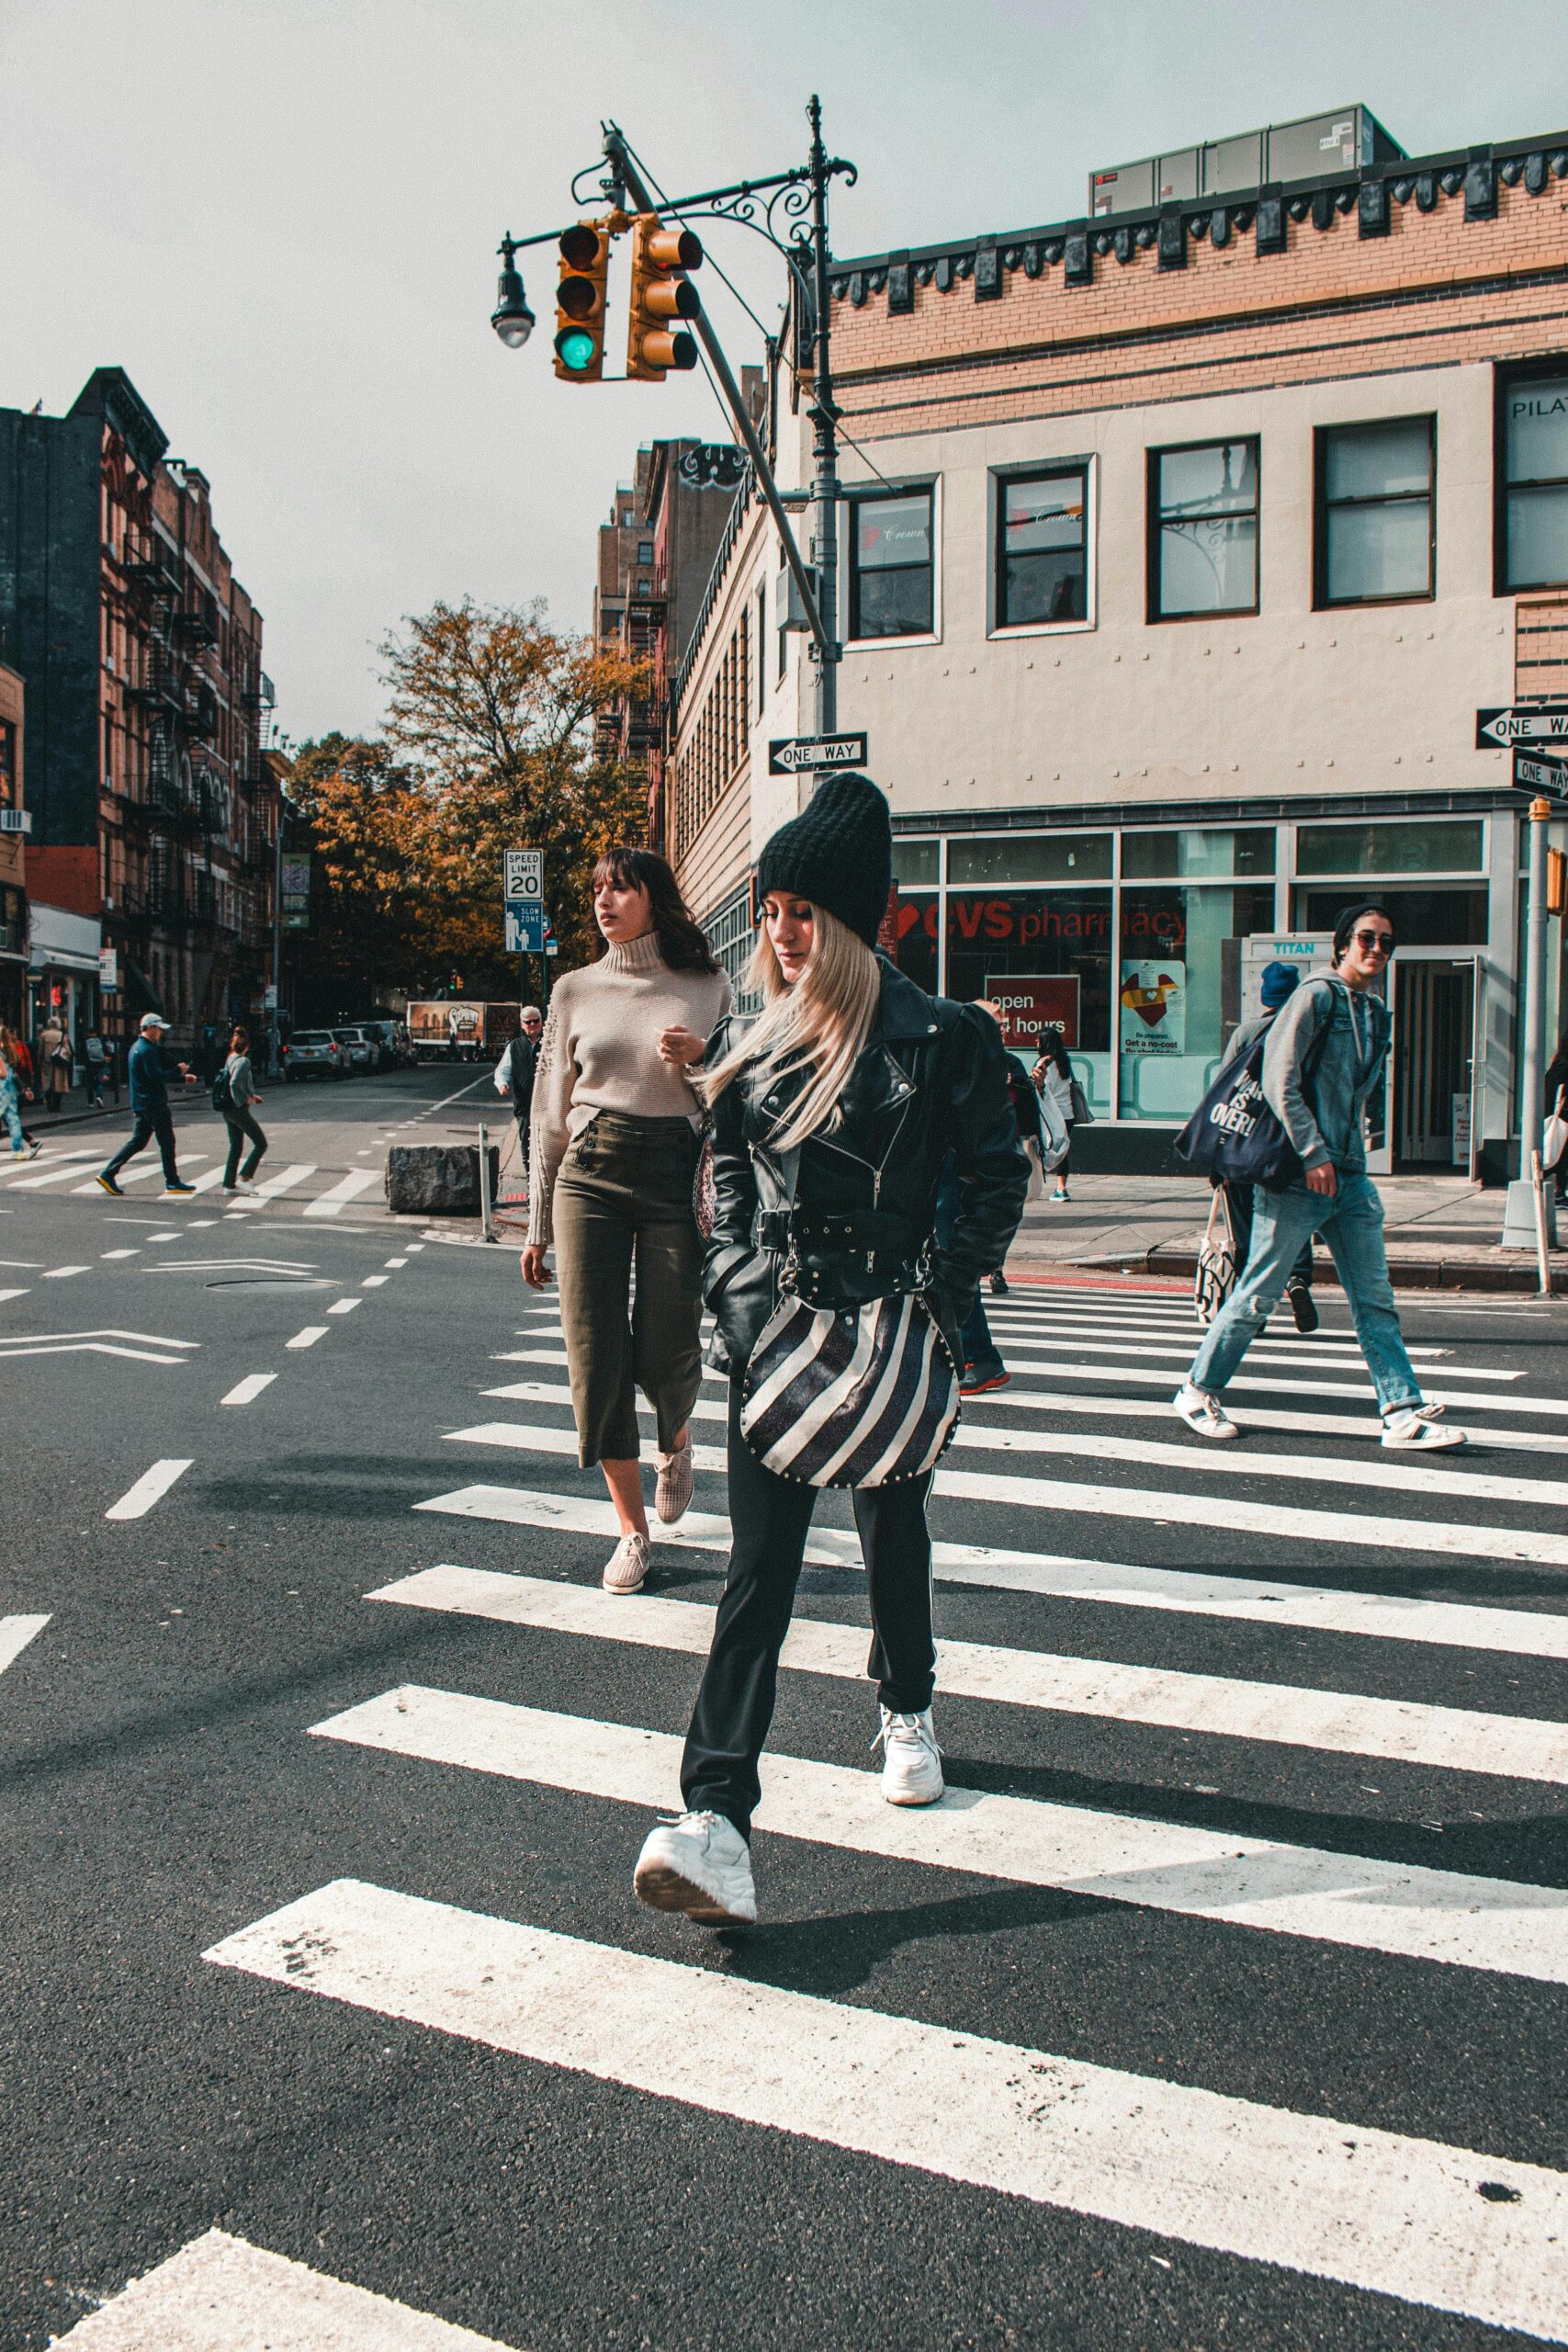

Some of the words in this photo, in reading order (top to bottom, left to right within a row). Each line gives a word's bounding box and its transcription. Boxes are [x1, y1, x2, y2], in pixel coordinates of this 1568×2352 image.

[1512, 396, 1568, 418] PILA
[1495, 719, 1531, 736] ONE
[784, 748, 811, 763] ONE
[825, 743, 854, 760] WAY
[1522, 762, 1542, 782] ONE
[509, 855, 538, 864] SPEED
[511, 865, 537, 874] LIMIT
[511, 876, 538, 894] 20
[521, 915, 540, 923] ZONE
[924, 899, 1013, 939] CVS
[1020, 905, 1186, 945] pharmacy
[1274, 942, 1314, 955] TITAN
[991, 996, 1034, 1014] open
[1016, 1016, 1066, 1034] hours
[1125, 1038, 1140, 1046] Get
[1148, 1040, 1178, 1048] no-cost
[1229, 1092, 1250, 1111] IS
[1210, 1102, 1257, 1137] OVER!
